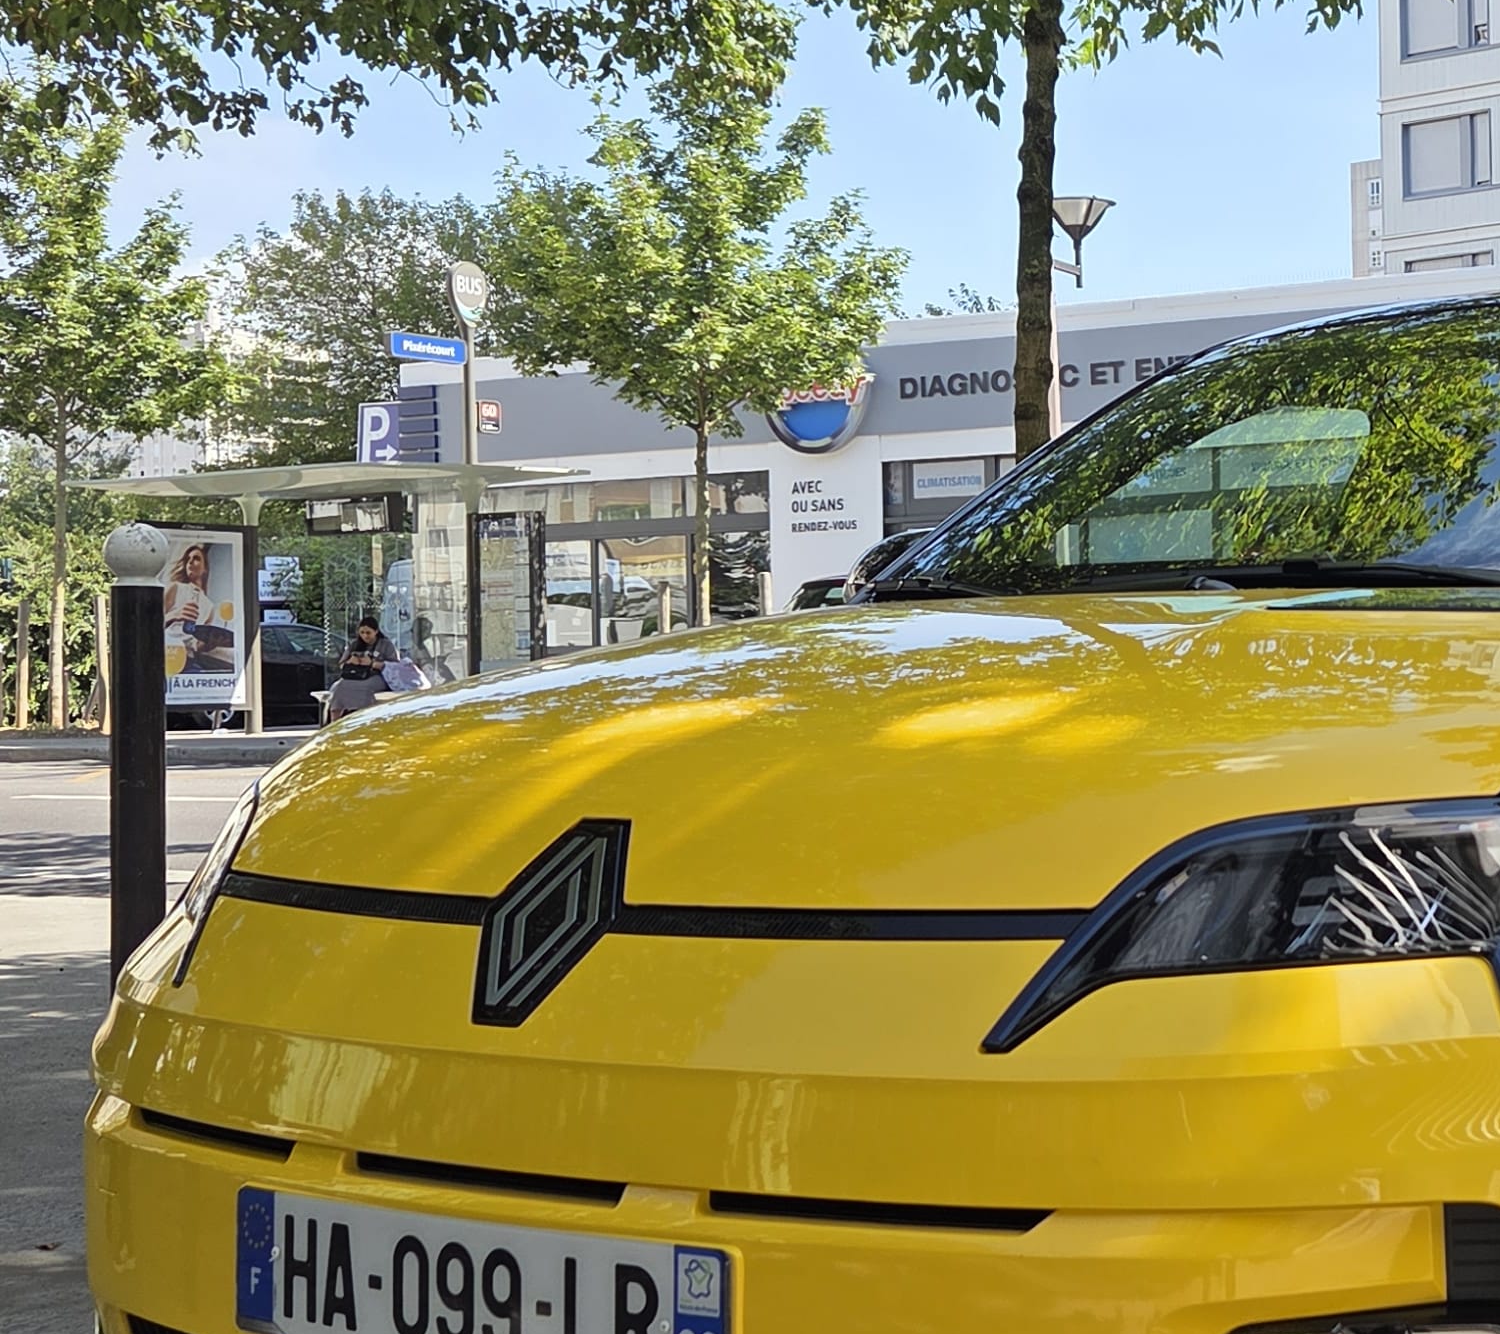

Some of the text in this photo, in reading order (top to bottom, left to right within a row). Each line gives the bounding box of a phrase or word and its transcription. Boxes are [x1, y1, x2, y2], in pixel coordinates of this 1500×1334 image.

[456, 274, 483, 296] BUS
[900, 364, 1079, 400] DIAGNOC
[1090, 360, 1125, 386] ET
[361, 407, 390, 463] P
[791, 480, 822, 495] AVEC
[917, 475, 982, 488] CLIMATISATION
[791, 498, 844, 513] OU SANS
[791, 520, 858, 533] RENDEZ-VOUS
[182, 679, 194, 688] LA
[196, 678, 236, 688] FRENCH
[249, 1265, 262, 1296] F
